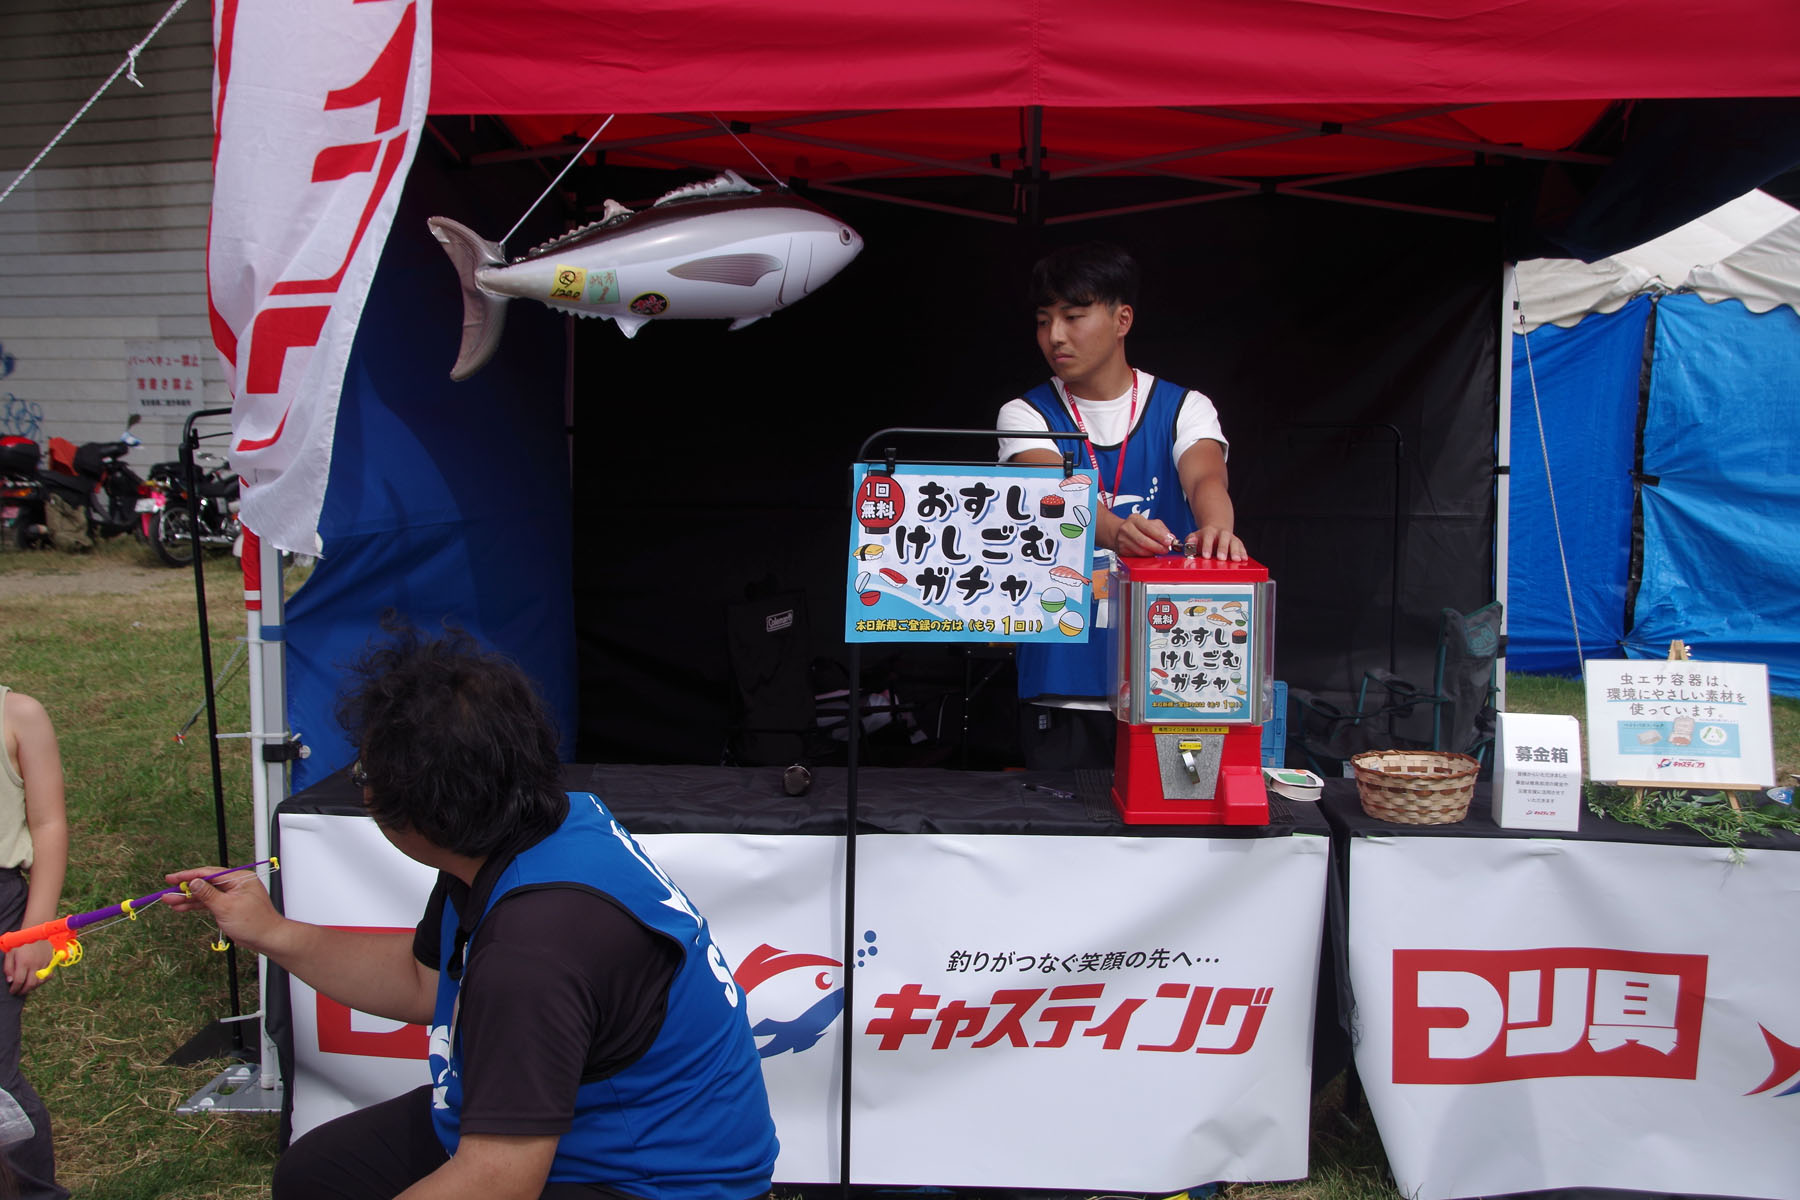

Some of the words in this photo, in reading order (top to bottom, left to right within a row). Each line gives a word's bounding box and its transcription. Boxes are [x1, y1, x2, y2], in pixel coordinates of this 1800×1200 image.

[865, 482, 890, 498] 1回
[860, 499, 896, 520] 無料
[916, 481, 1035, 524] おすし
[895, 525, 1058, 563] けしごむ
[915, 565, 1031, 605] ガチャ
[1155, 604, 1171, 613] 1回
[1152, 614, 1174, 625] 無料
[1170, 627, 1229, 647] おすし
[1160, 650, 1241, 669] けしごむ
[1170, 672, 1230, 692] ガチャ
[1620, 673, 1729, 688] 虫エサ容器は、
[1607, 688, 1746, 703] 環境にやさしい素材を
[1629, 702, 1724, 718] 使っています。
[1515, 746, 1569, 764] 募金箱
[864, 982, 1275, 1055] キャスティング
[1416, 966, 1681, 1060] つり具
